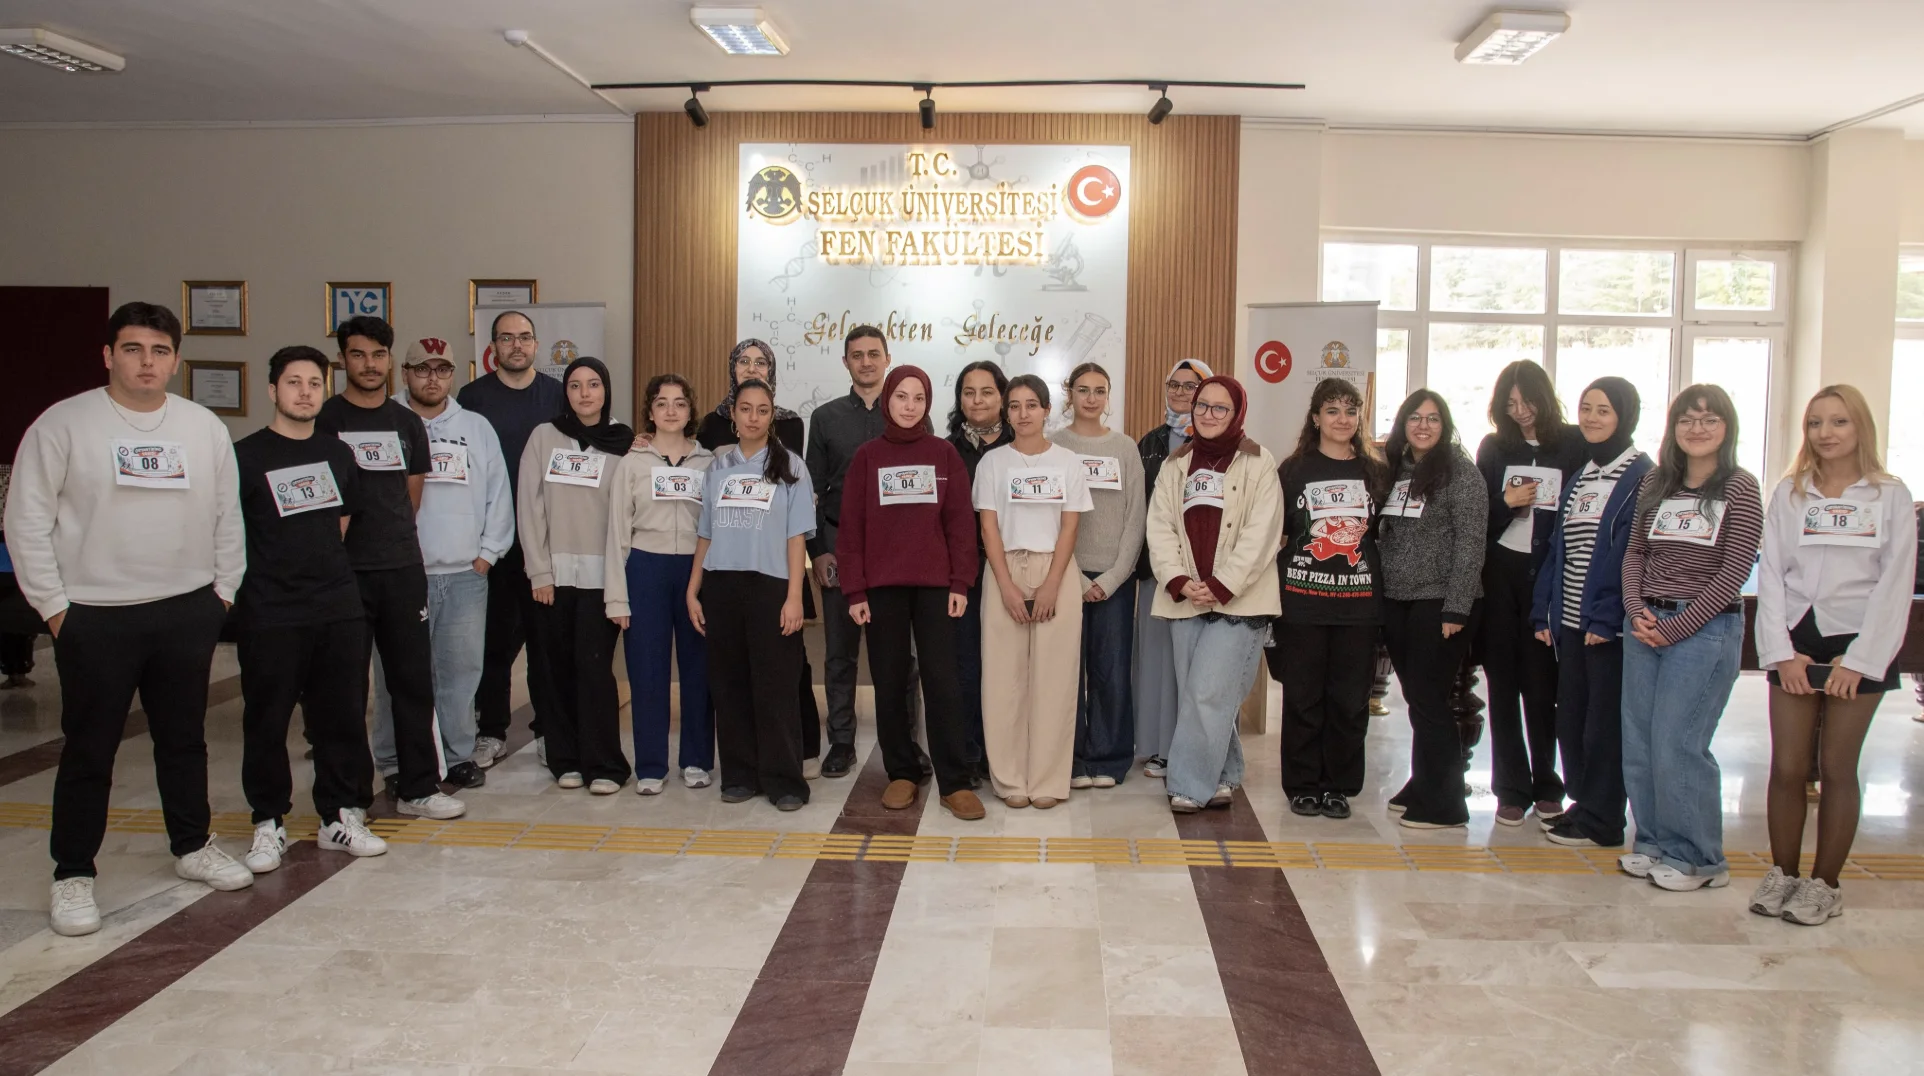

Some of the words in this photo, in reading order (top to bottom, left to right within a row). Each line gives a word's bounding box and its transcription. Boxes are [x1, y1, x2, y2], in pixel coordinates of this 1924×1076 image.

[822, 154, 832, 163] H
[808, 191, 894, 223] SELÇUK
[902, 182, 1058, 215] ÜNİVERSİTESİ
[820, 231, 876, 256] FEN
[886, 221, 1044, 257] FAKÜLTESİ
[787, 297, 796, 306] H
[752, 312, 762, 322] H
[804, 309, 933, 346] Gelkten
[954, 313, 1055, 356] Geleceğe
[419, 338, 447, 355] W
[820, 346, 830, 355] H
[786, 361, 796, 371] H
[365, 450, 380, 461] 09
[142, 457, 159, 470] 08
[437, 460, 449, 472] 17
[570, 462, 582, 472] 16
[1088, 466, 1099, 477] 14
[673, 481, 687, 492] 03
[741, 485, 753, 495] 10
[901, 479, 915, 490] 04
[1031, 484, 1042, 494] 11
[1195, 481, 1208, 492] 06
[300, 486, 315, 500] 13
[1331, 492, 1345, 503] 02
[1397, 491, 1407, 502] 12
[1579, 501, 1591, 513] 05
[1678, 519, 1692, 530] 15
[1831, 514, 1848, 527] 18
[1287, 567, 1308, 581] BEST
[1309, 571, 1336, 585] PIZZA
[1337, 574, 1349, 586] IN
[1349, 573, 1372, 586] TOWN
